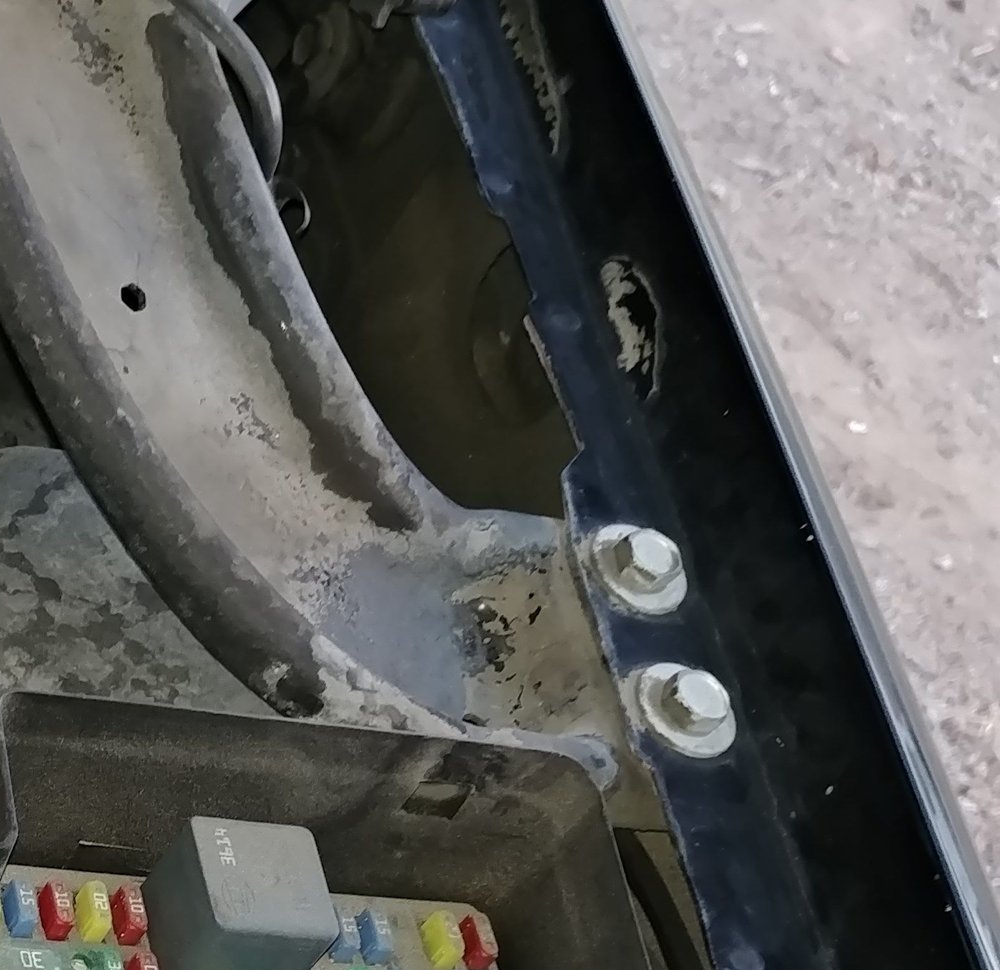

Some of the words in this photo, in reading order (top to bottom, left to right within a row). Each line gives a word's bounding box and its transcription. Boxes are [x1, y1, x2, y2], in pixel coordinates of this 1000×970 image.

[20, 888, 35, 906] 15
[55, 891, 70, 908] 10
[93, 892, 110, 911] 20
[129, 893, 145, 914] 10
[342, 917, 357, 933] 15
[20, 950, 44, 970] 30
